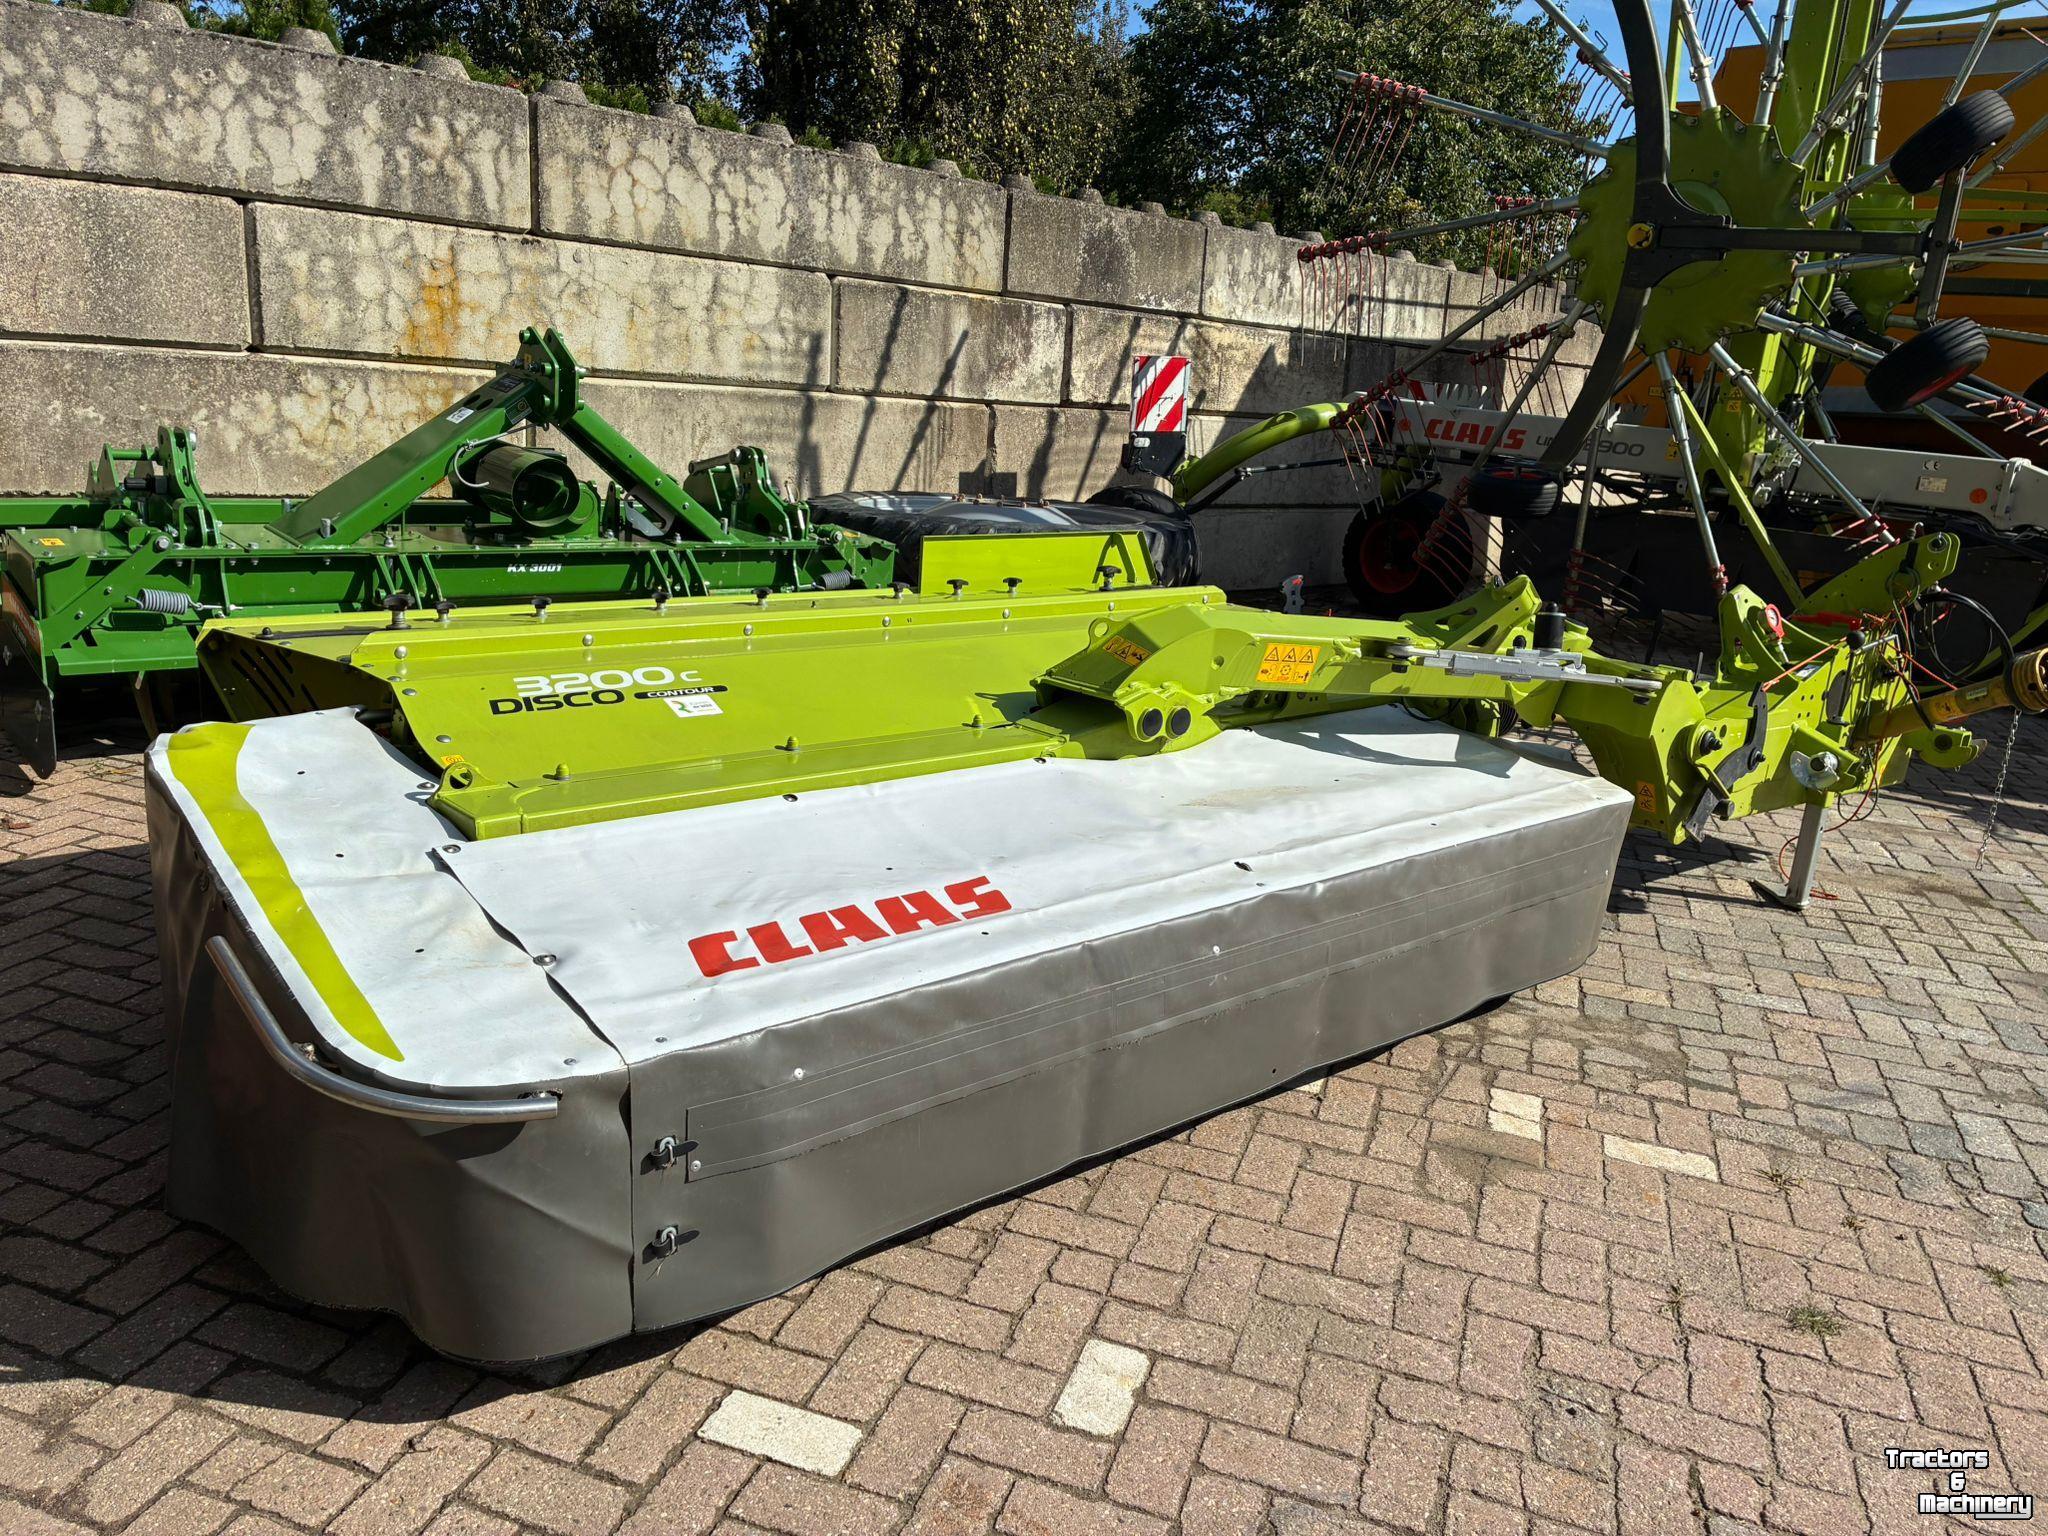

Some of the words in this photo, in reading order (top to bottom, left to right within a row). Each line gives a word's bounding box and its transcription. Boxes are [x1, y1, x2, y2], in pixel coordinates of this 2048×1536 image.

[507, 563, 527, 573] KX
[529, 563, 563, 573] 3001
[512, 666, 675, 697] 3200
[489, 689, 625, 715] DISCO
[647, 686, 715, 698] CONTOUR
[688, 875, 1012, 977] CLAAS
